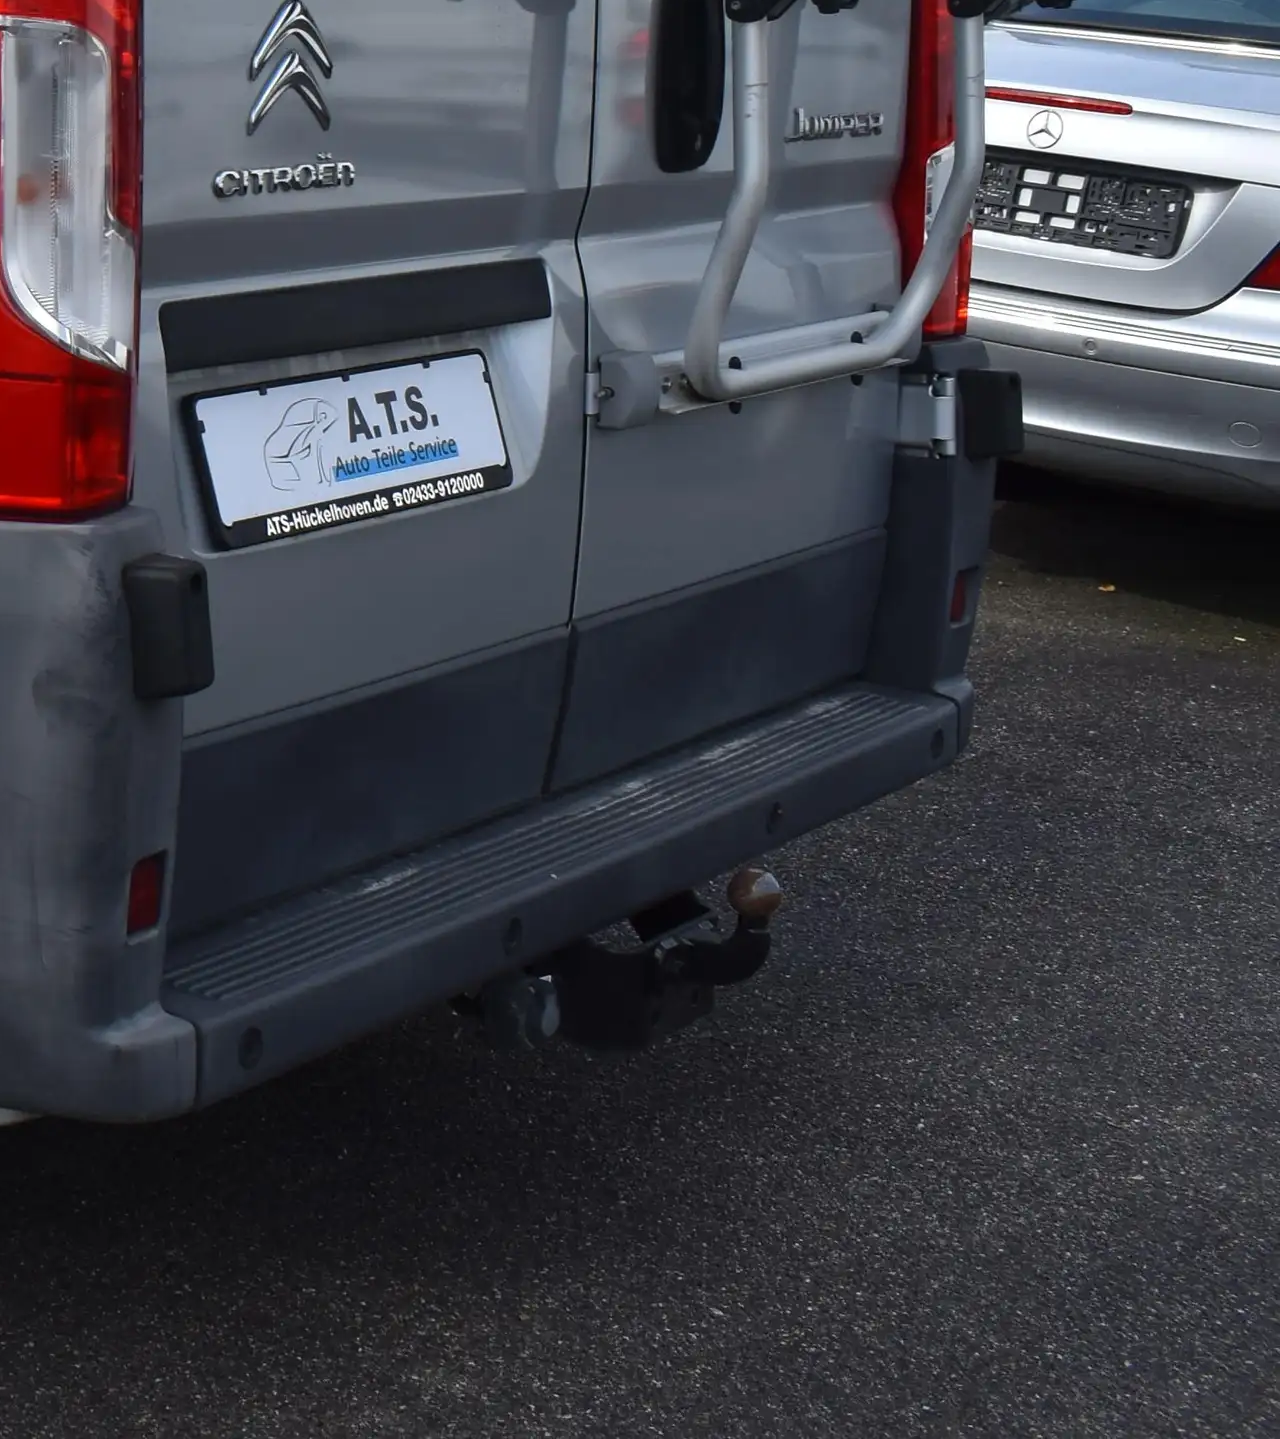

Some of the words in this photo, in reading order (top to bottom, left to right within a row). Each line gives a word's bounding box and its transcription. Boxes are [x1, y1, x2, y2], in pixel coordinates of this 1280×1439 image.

[347, 386, 439, 443] A.T.S.
[335, 455, 371, 479] Auto
[375, 447, 406, 468] Teile
[409, 436, 458, 463] Service
[266, 495, 389, 537] ATS-Hückelhoven.de
